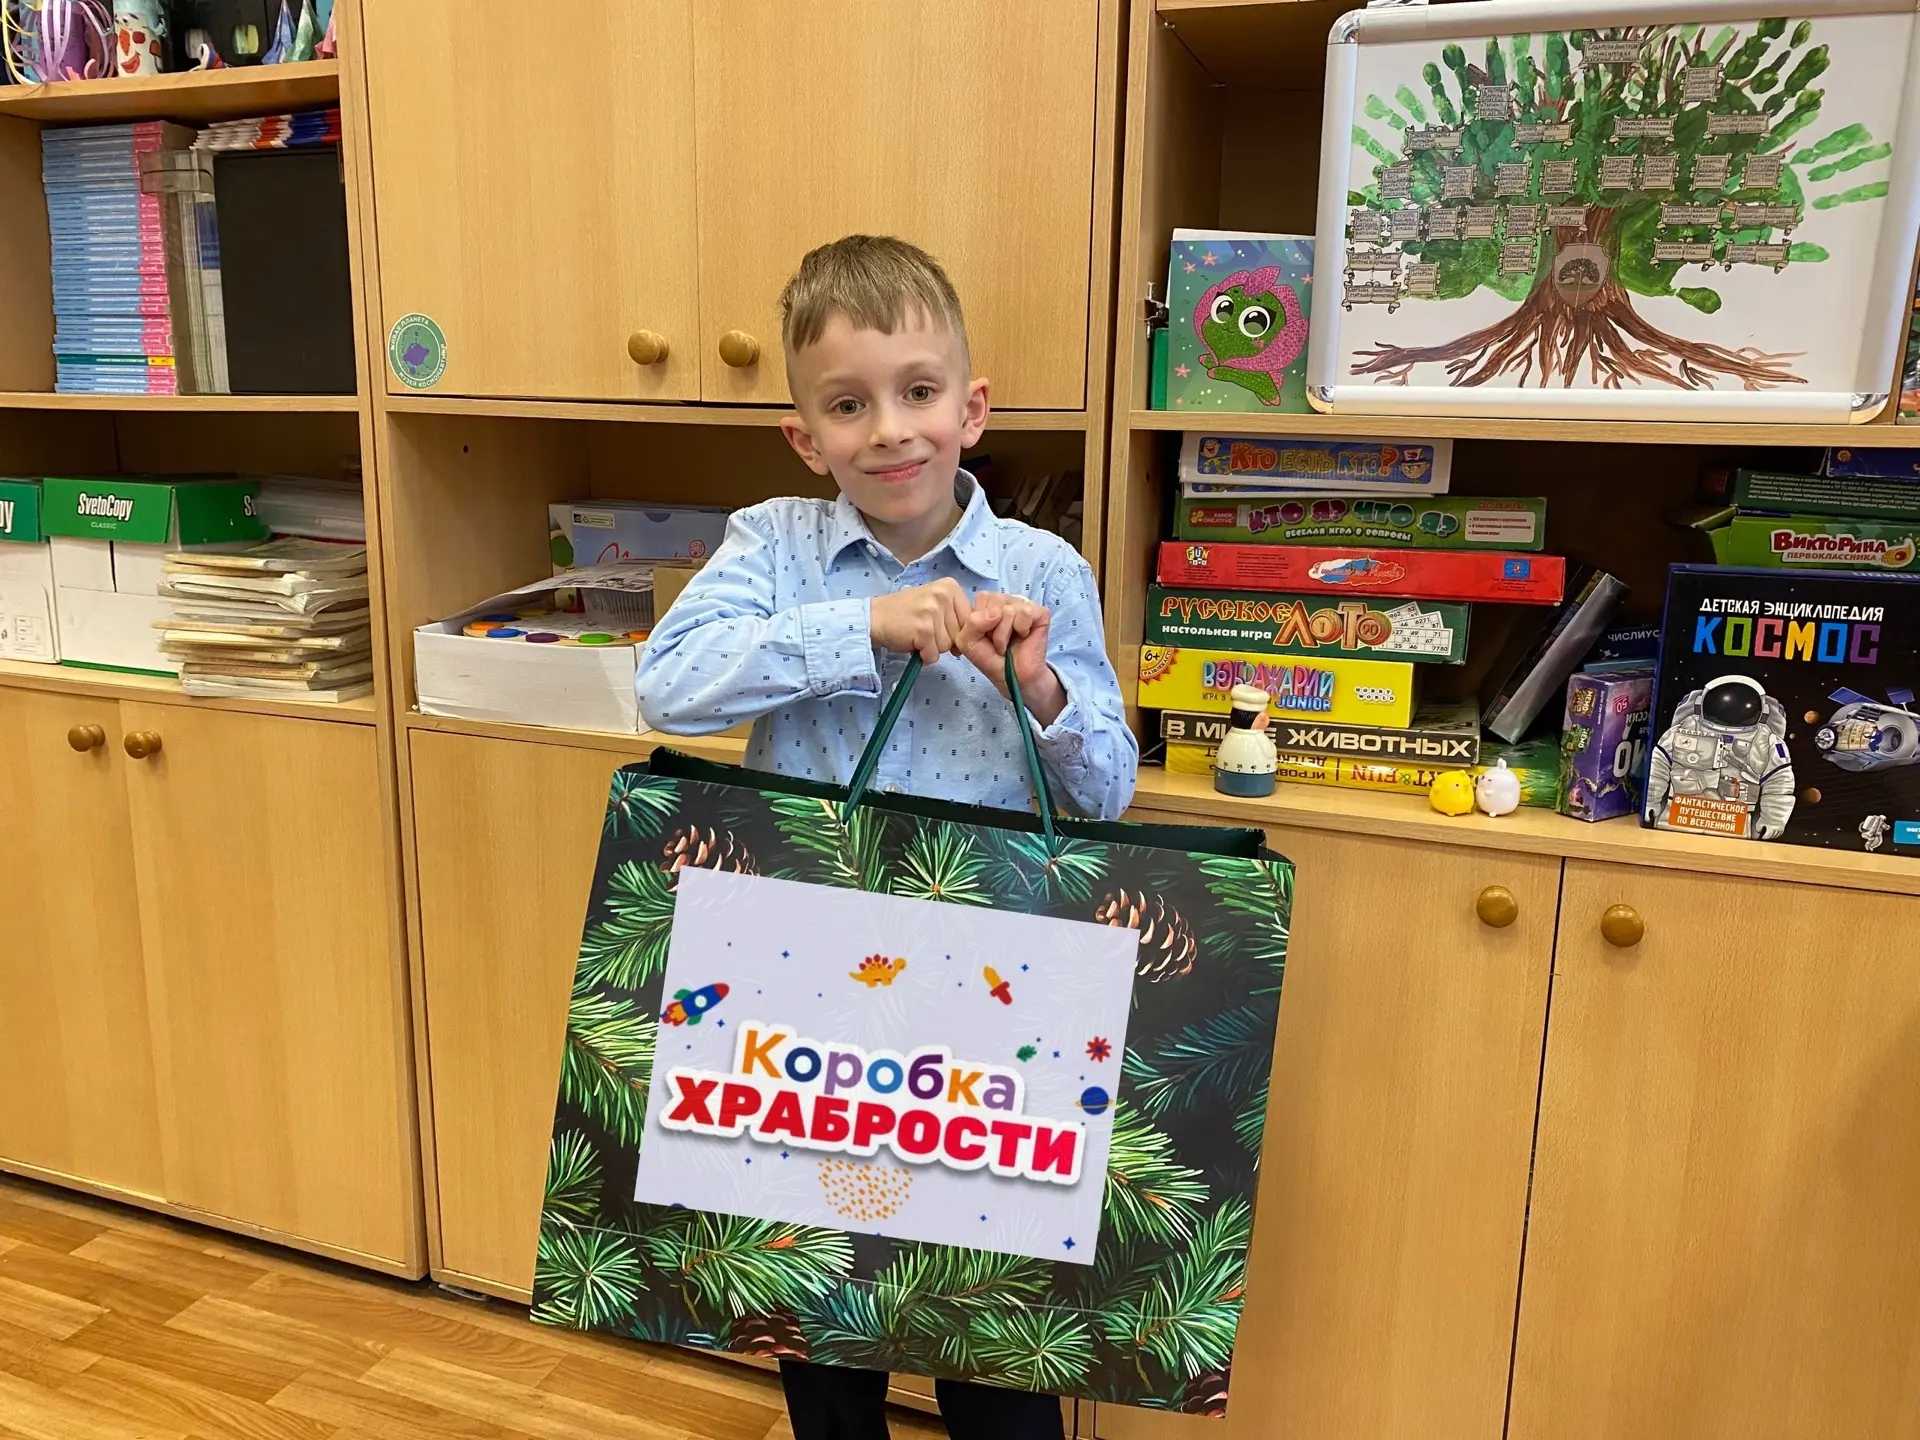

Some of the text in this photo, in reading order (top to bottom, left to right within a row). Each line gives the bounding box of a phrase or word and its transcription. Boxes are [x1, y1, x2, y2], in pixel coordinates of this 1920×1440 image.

[401, 316, 429, 326] ПЛАНЕТА
[1279, 450, 1335, 474] ЕСТЬ
[78, 493, 133, 521] SvetoCopy
[1247, 501, 1305, 533] КТО
[1352, 500, 1415, 527] ЧТО
[1284, 527, 1325, 538] ВЕСЕЛАЯ
[1328, 526, 1352, 535] ИГРА
[1365, 528, 1412, 541] ВОПРОСЫ
[1787, 552, 1877, 561] ПЕРВОКЛАССНИКА
[1699, 598, 1884, 622] ДЕТСКАЯ ЭНЦИКЛОПЕДИЯ
[1162, 624, 1272, 640] настольная игра
[1693, 616, 1881, 664] КОСМОС
[1144, 650, 1160, 661] 6+
[1202, 692, 1218, 701] ИГРА
[1355, 686, 1391, 695] HOBBY
[1358, 693, 1395, 702] WORLD
[1275, 695, 1332, 711] JUNIOR
[1166, 719, 1186, 735] В
[1287, 727, 1472, 758] ЖИВОТНЫХ
[1674, 796, 1746, 814] ФАНТАСТИЧЕСКОЕ
[1679, 806, 1737, 822] ПУТЕШЕСТВИЕ
[1677, 815, 1736, 832] ПО ВСЕЛЕННОЙ
[741, 1030, 1016, 1111] Коробка
[668, 1075, 1077, 1176] ХРАБРОСТИ
